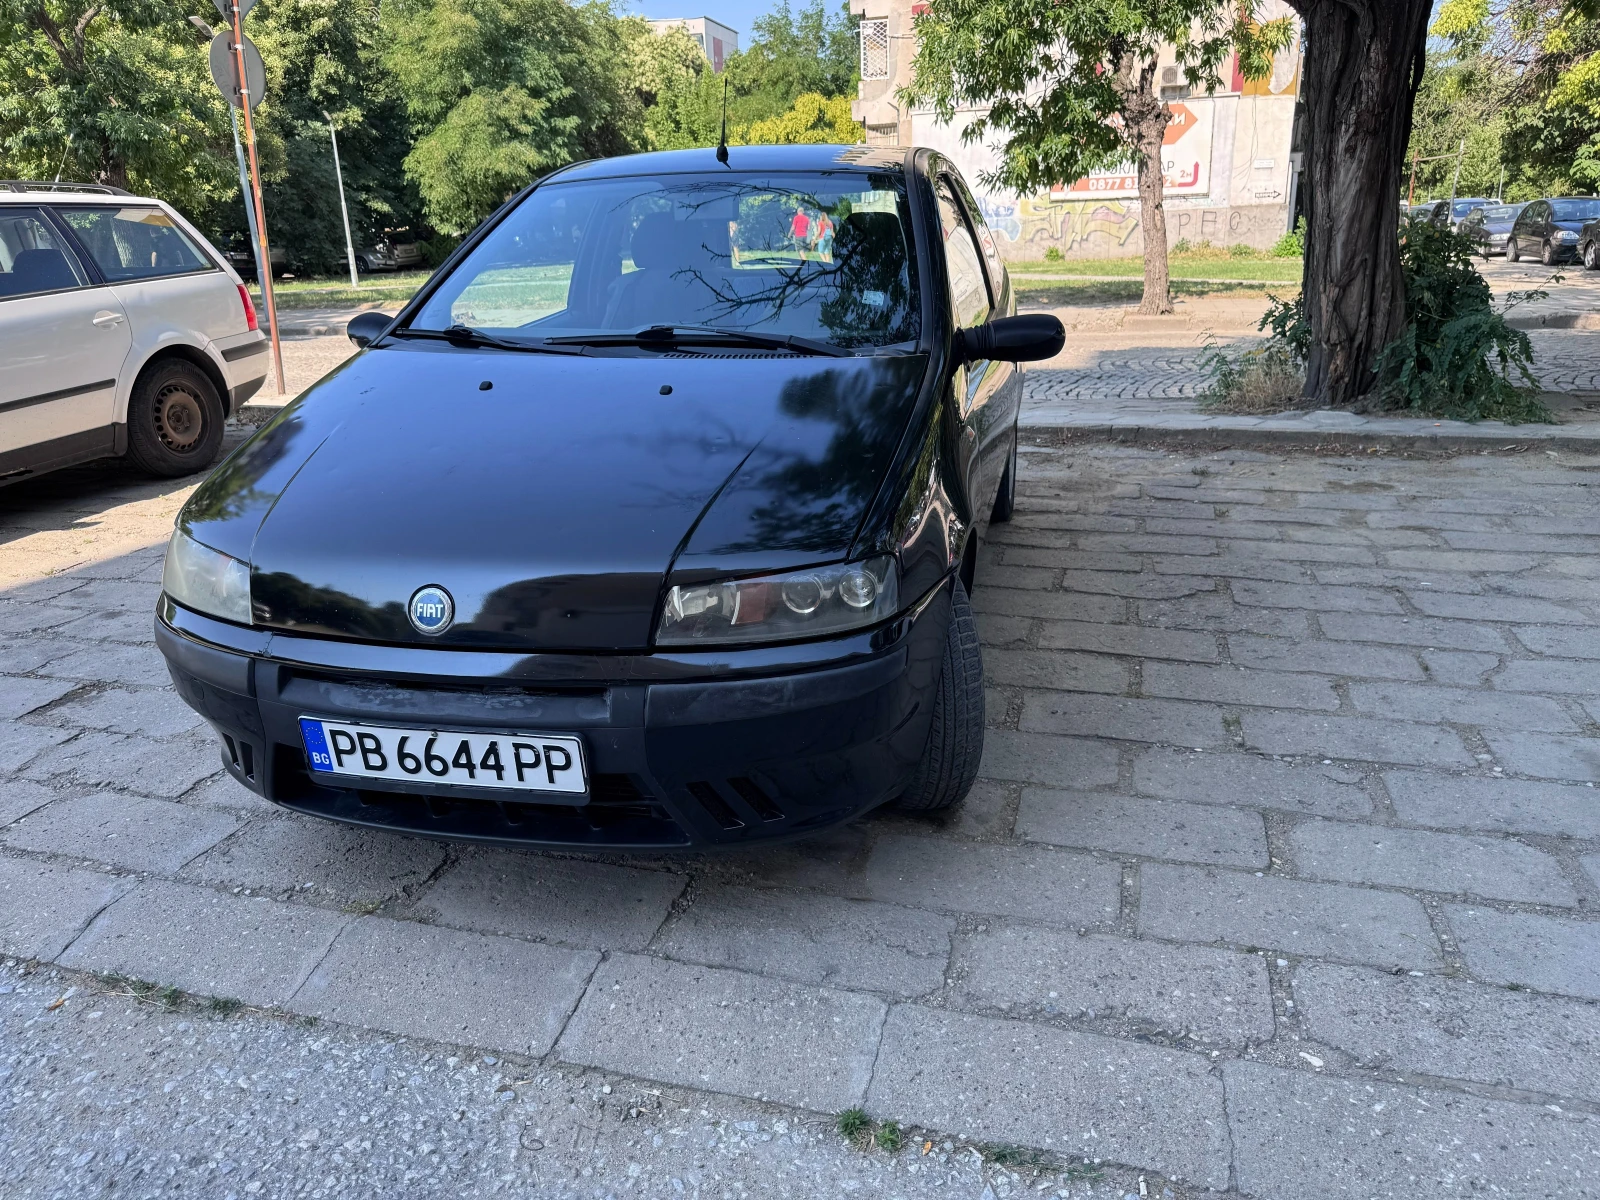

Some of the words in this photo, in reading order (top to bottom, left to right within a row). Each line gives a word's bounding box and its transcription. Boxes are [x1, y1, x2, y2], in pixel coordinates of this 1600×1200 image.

[1088, 178, 1121, 190] 0877
[416, 602, 444, 618] FIAT
[311, 751, 330, 765] BG
[328, 728, 389, 772] PB
[396, 735, 505, 781] 6644
[512, 742, 572, 784] PP
